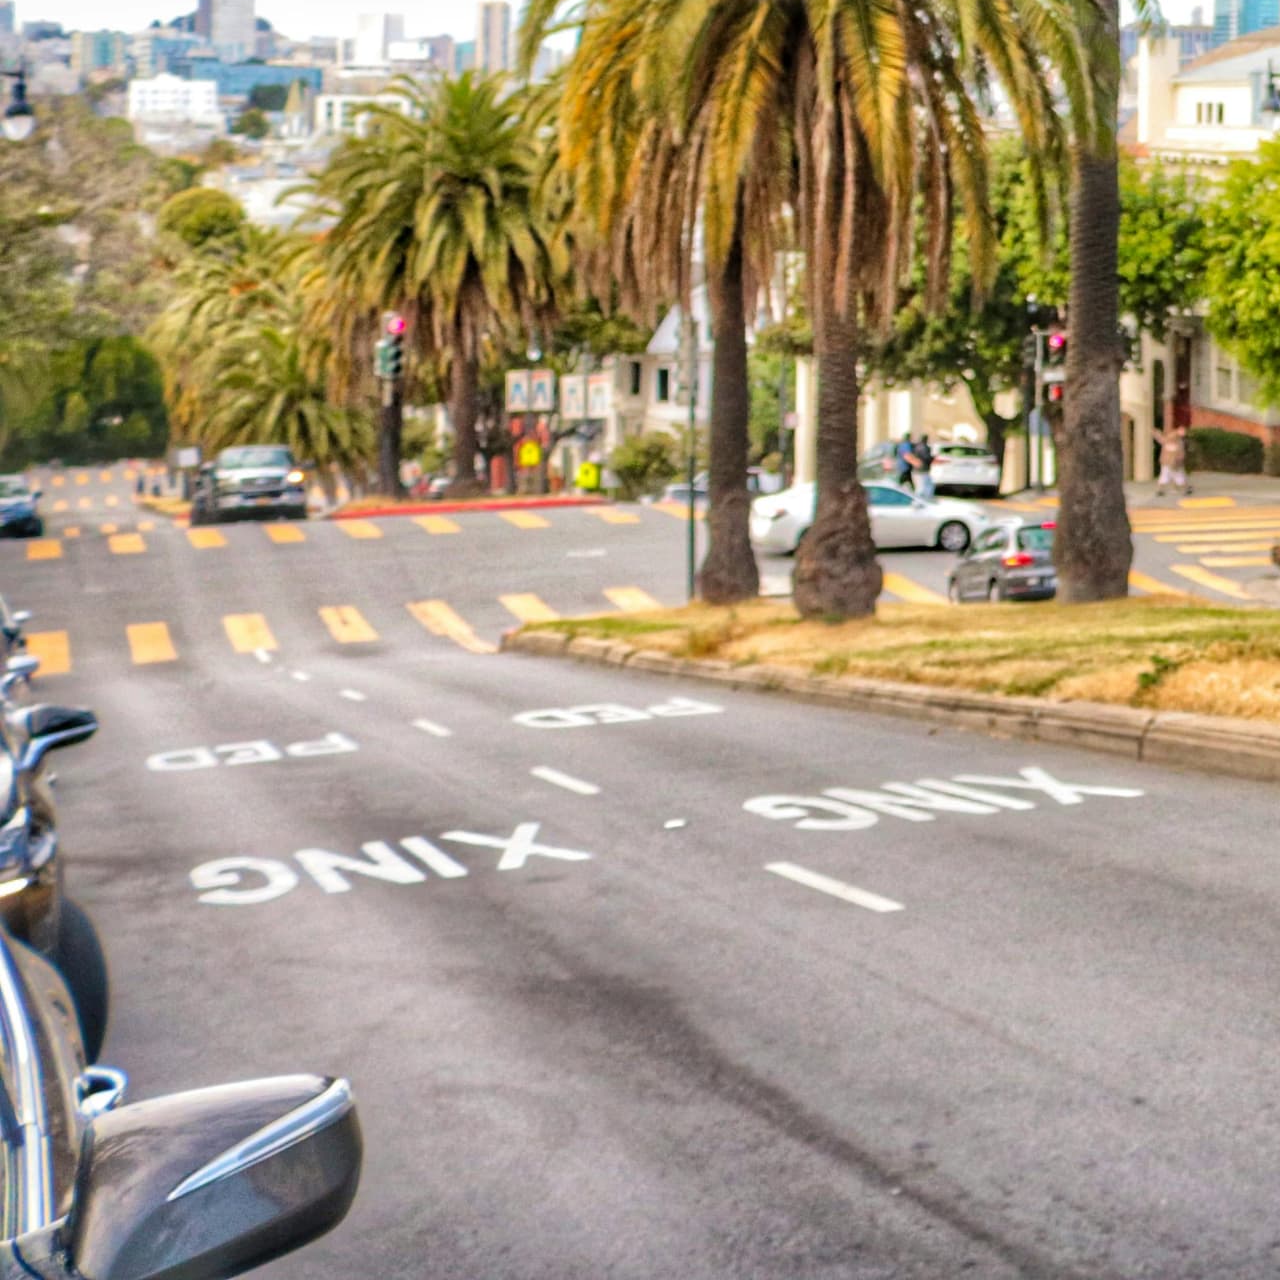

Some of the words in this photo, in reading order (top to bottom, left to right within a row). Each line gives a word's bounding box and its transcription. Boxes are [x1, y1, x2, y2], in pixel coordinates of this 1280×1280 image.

[512, 696, 725, 729] PED
[146, 732, 359, 772] PED
[742, 767, 1144, 831] XING
[190, 822, 592, 905] XING
